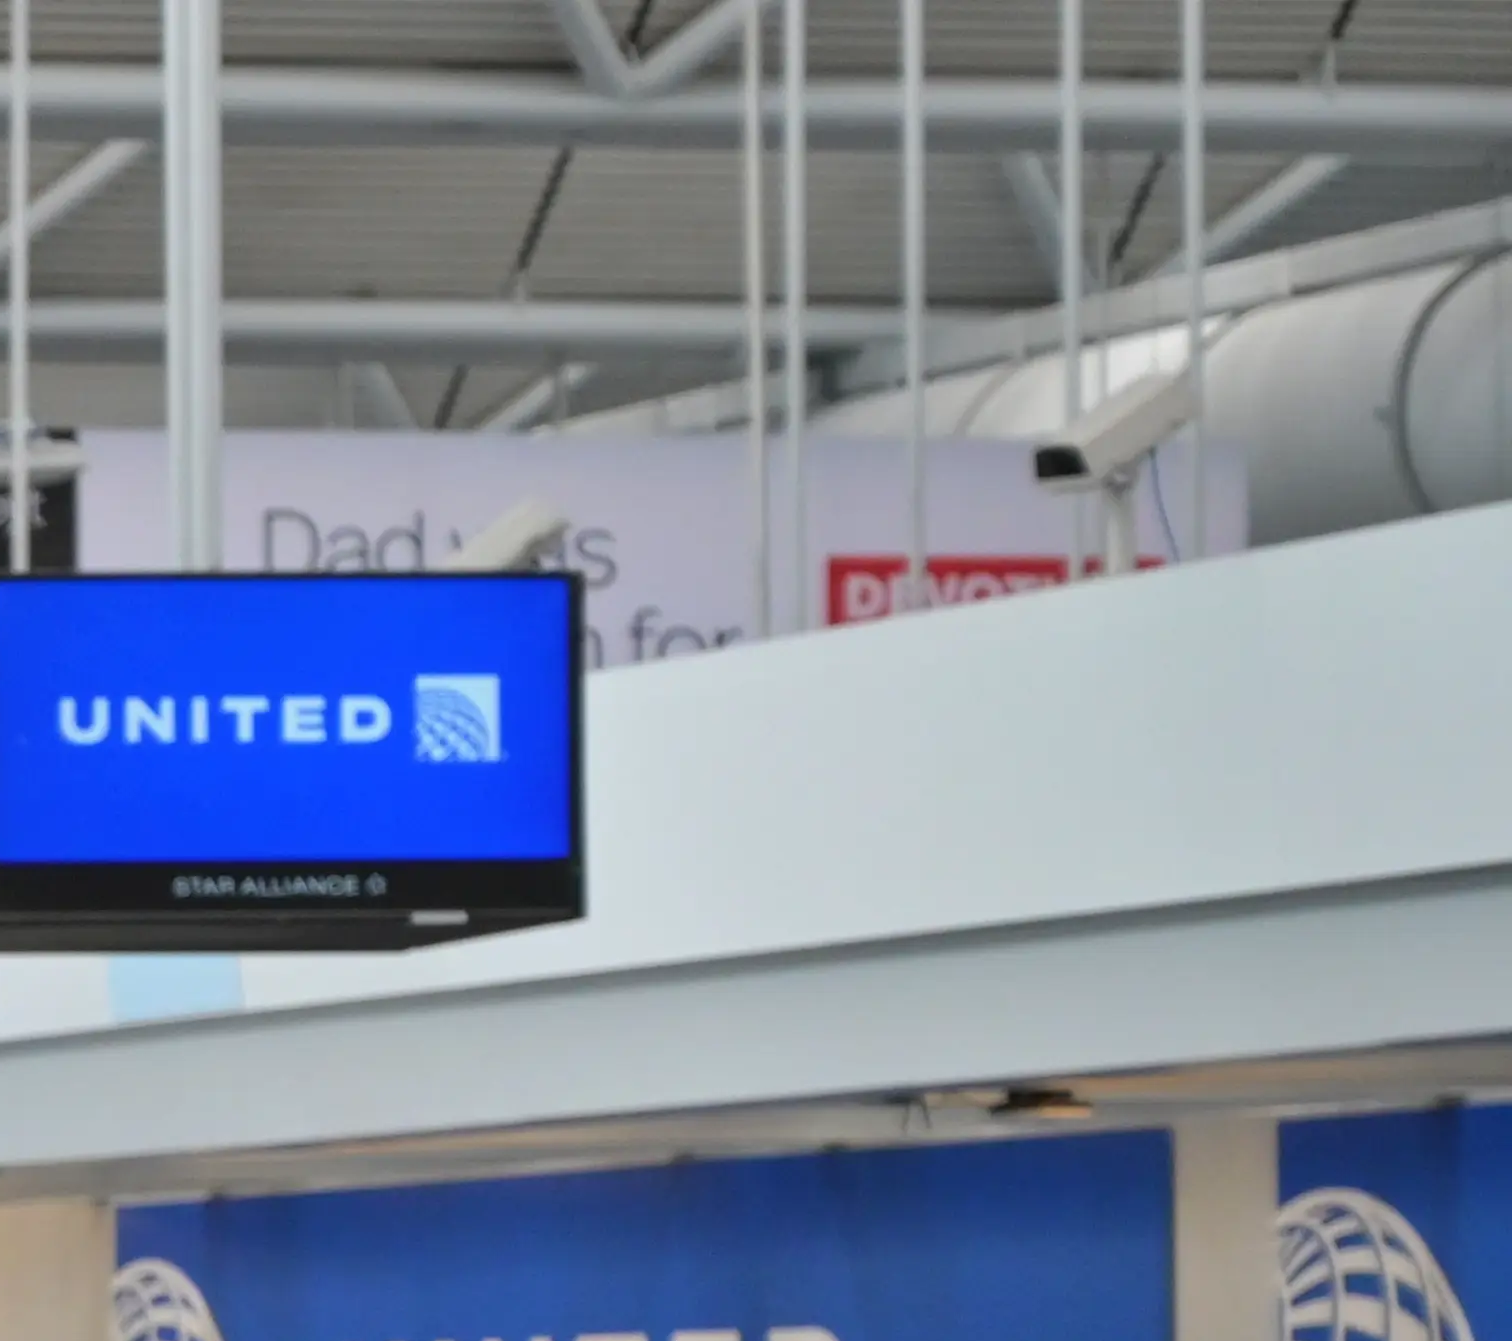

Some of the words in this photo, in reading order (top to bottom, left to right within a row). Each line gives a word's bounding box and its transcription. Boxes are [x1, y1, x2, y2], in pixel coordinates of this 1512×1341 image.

[264, 508, 426, 574] Dad
[59, 695, 391, 745] UNITED
[173, 878, 234, 897] STAR
[241, 875, 359, 897] ALLIANCE
